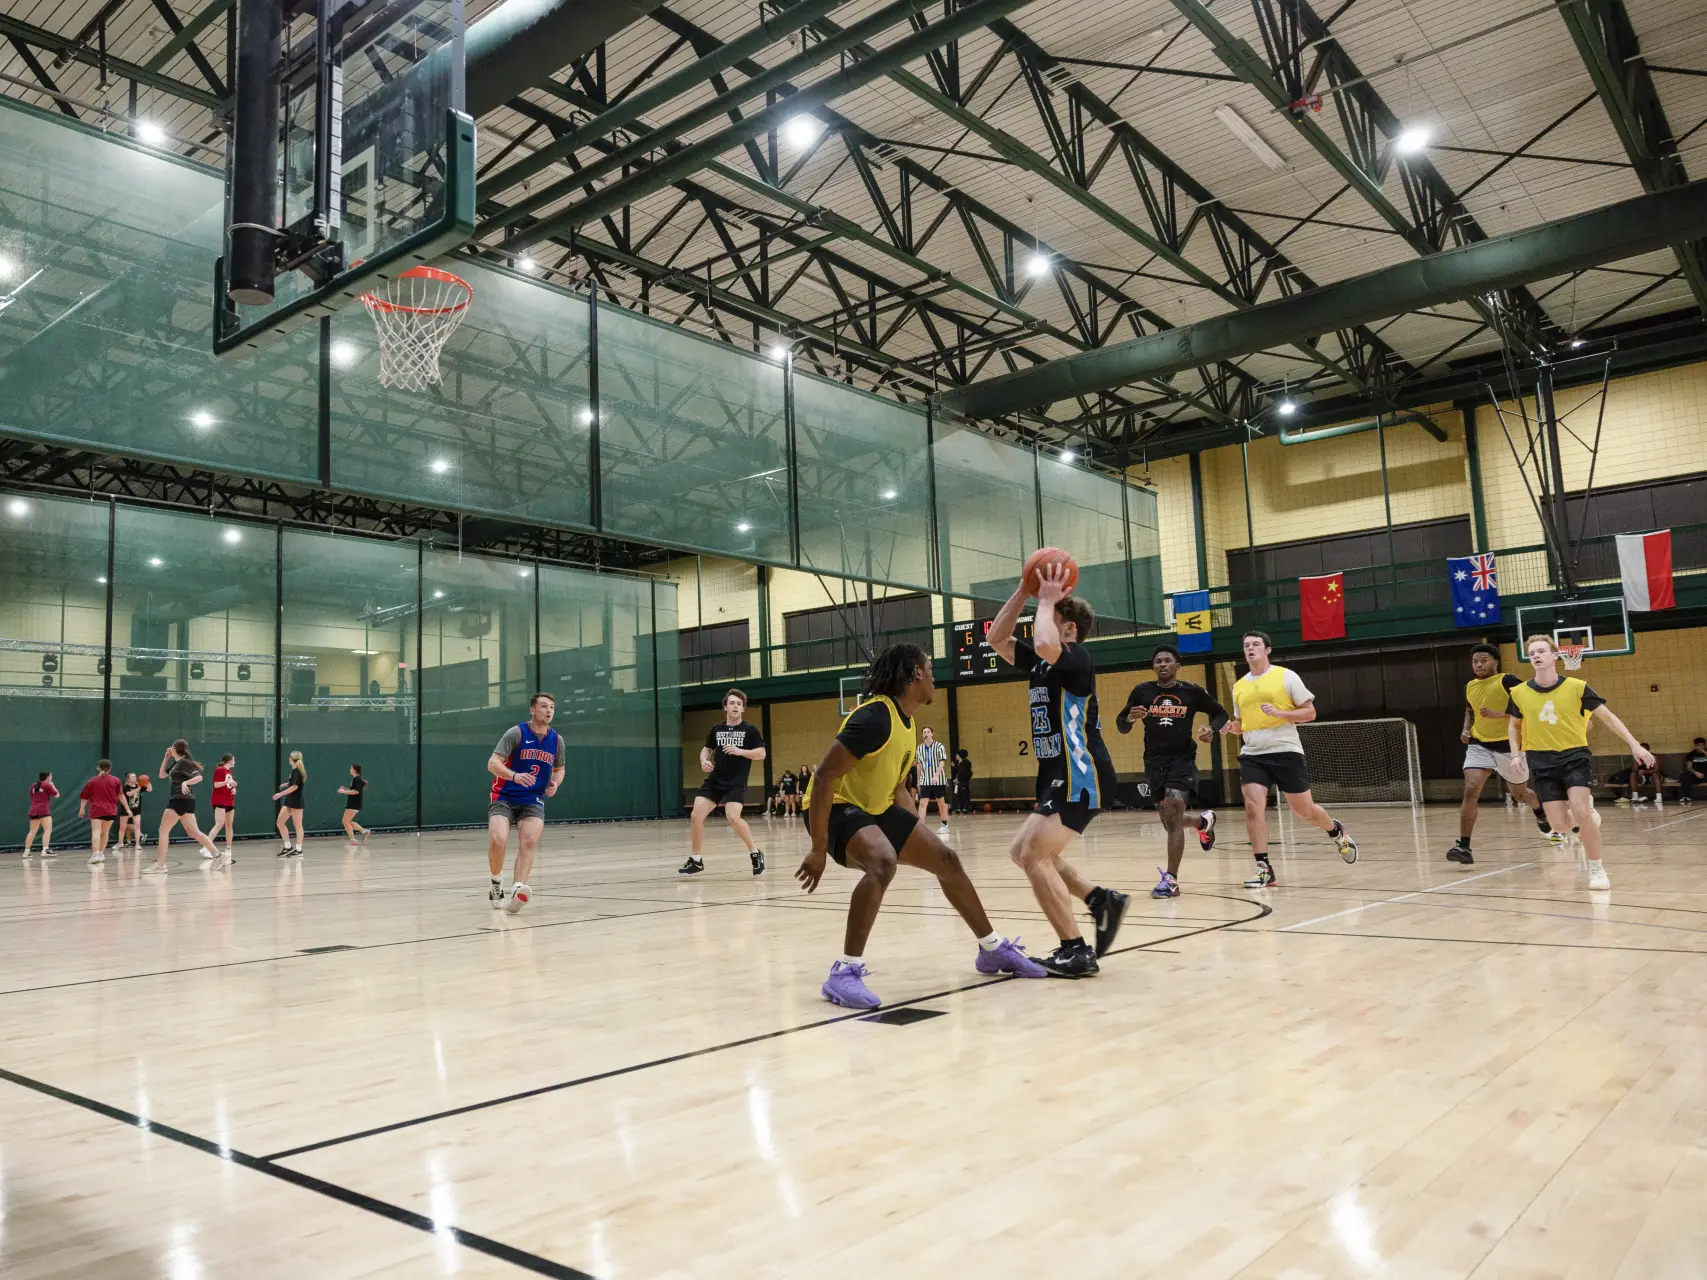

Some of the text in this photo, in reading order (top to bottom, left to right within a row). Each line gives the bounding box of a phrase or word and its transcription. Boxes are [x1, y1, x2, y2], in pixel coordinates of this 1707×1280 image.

[954, 623, 974, 631] GUEST
[965, 631, 973, 645] 6
[967, 660, 971, 670] 1
[990, 657, 996, 668] 0
[1538, 699, 1559, 726] 4
[1031, 705, 1052, 735] 23
[716, 737, 744, 747] TOUGH
[1018, 740, 1029, 756] 2
[530, 764, 541, 777] 2
